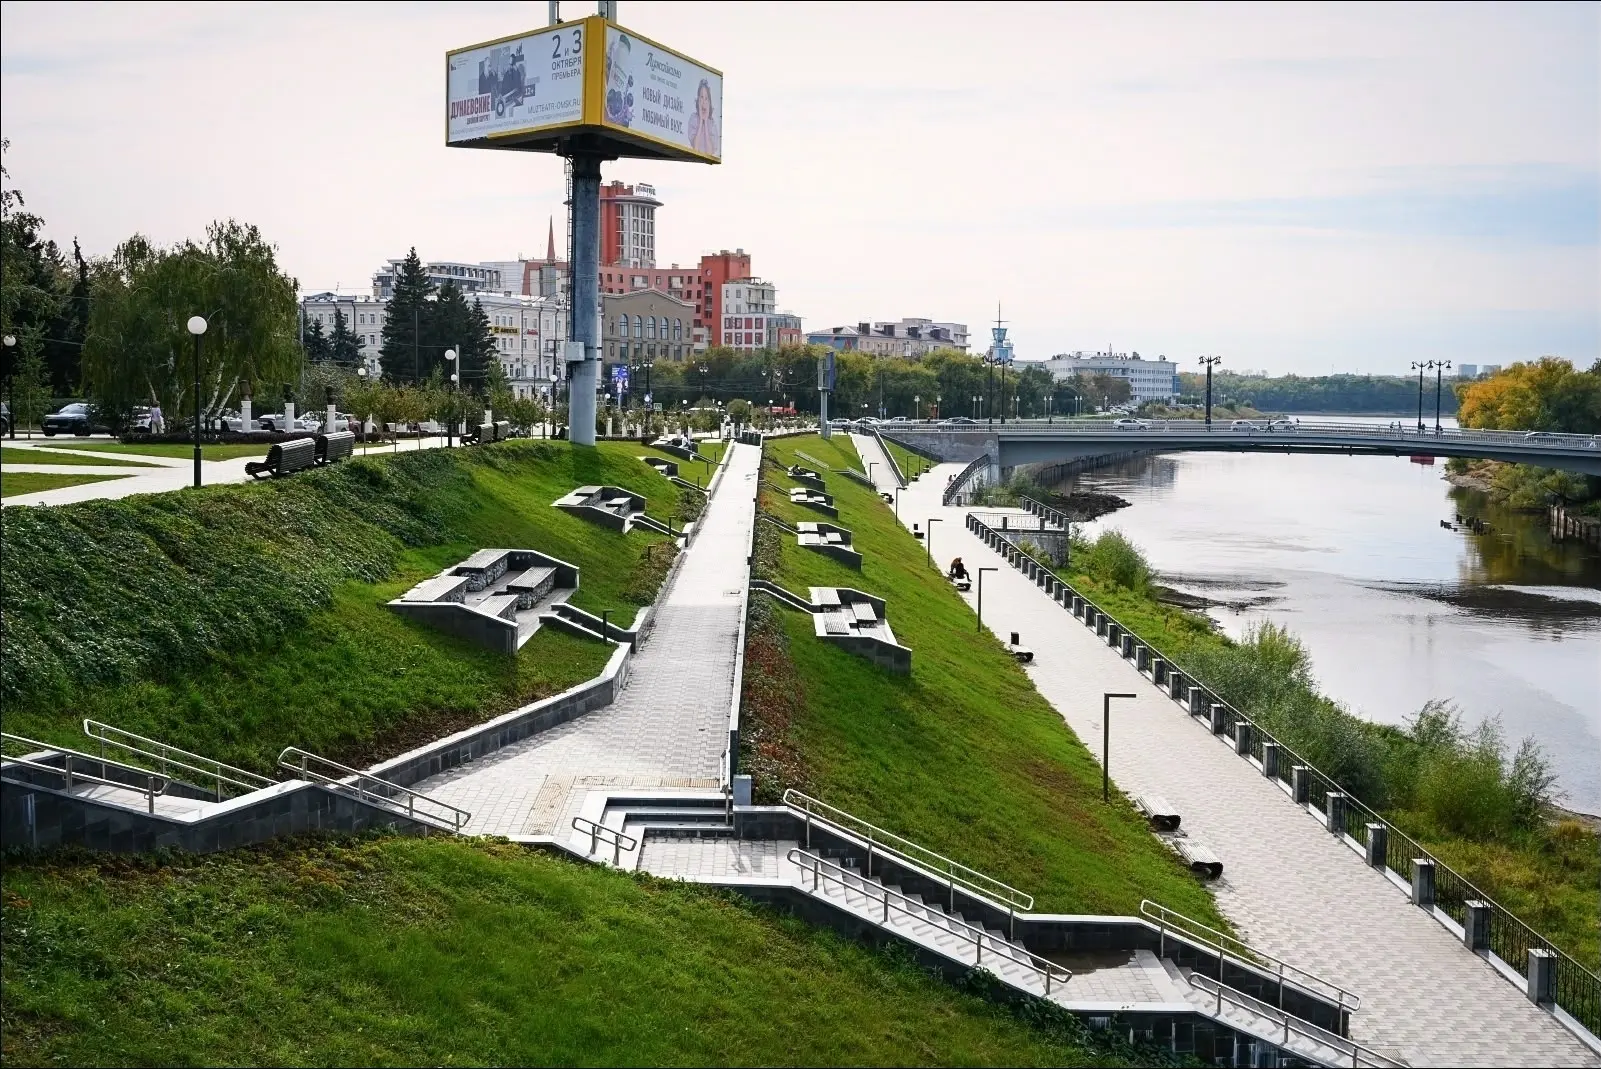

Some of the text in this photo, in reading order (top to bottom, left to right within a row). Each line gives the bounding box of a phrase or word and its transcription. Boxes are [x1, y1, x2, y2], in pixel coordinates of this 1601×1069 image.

[552, 34, 561, 59] 2
[572, 29, 582, 54] 3
[551, 56, 582, 70] ОКТЯБРЯ
[551, 68, 581, 81] ПРЕМЬЕРА
[642, 86, 661, 104] НОВЫЙ
[450, 94, 491, 120] ДУНАЕВСКИЕ
[642, 108, 670, 130] ЛЮБИМЫЙ
